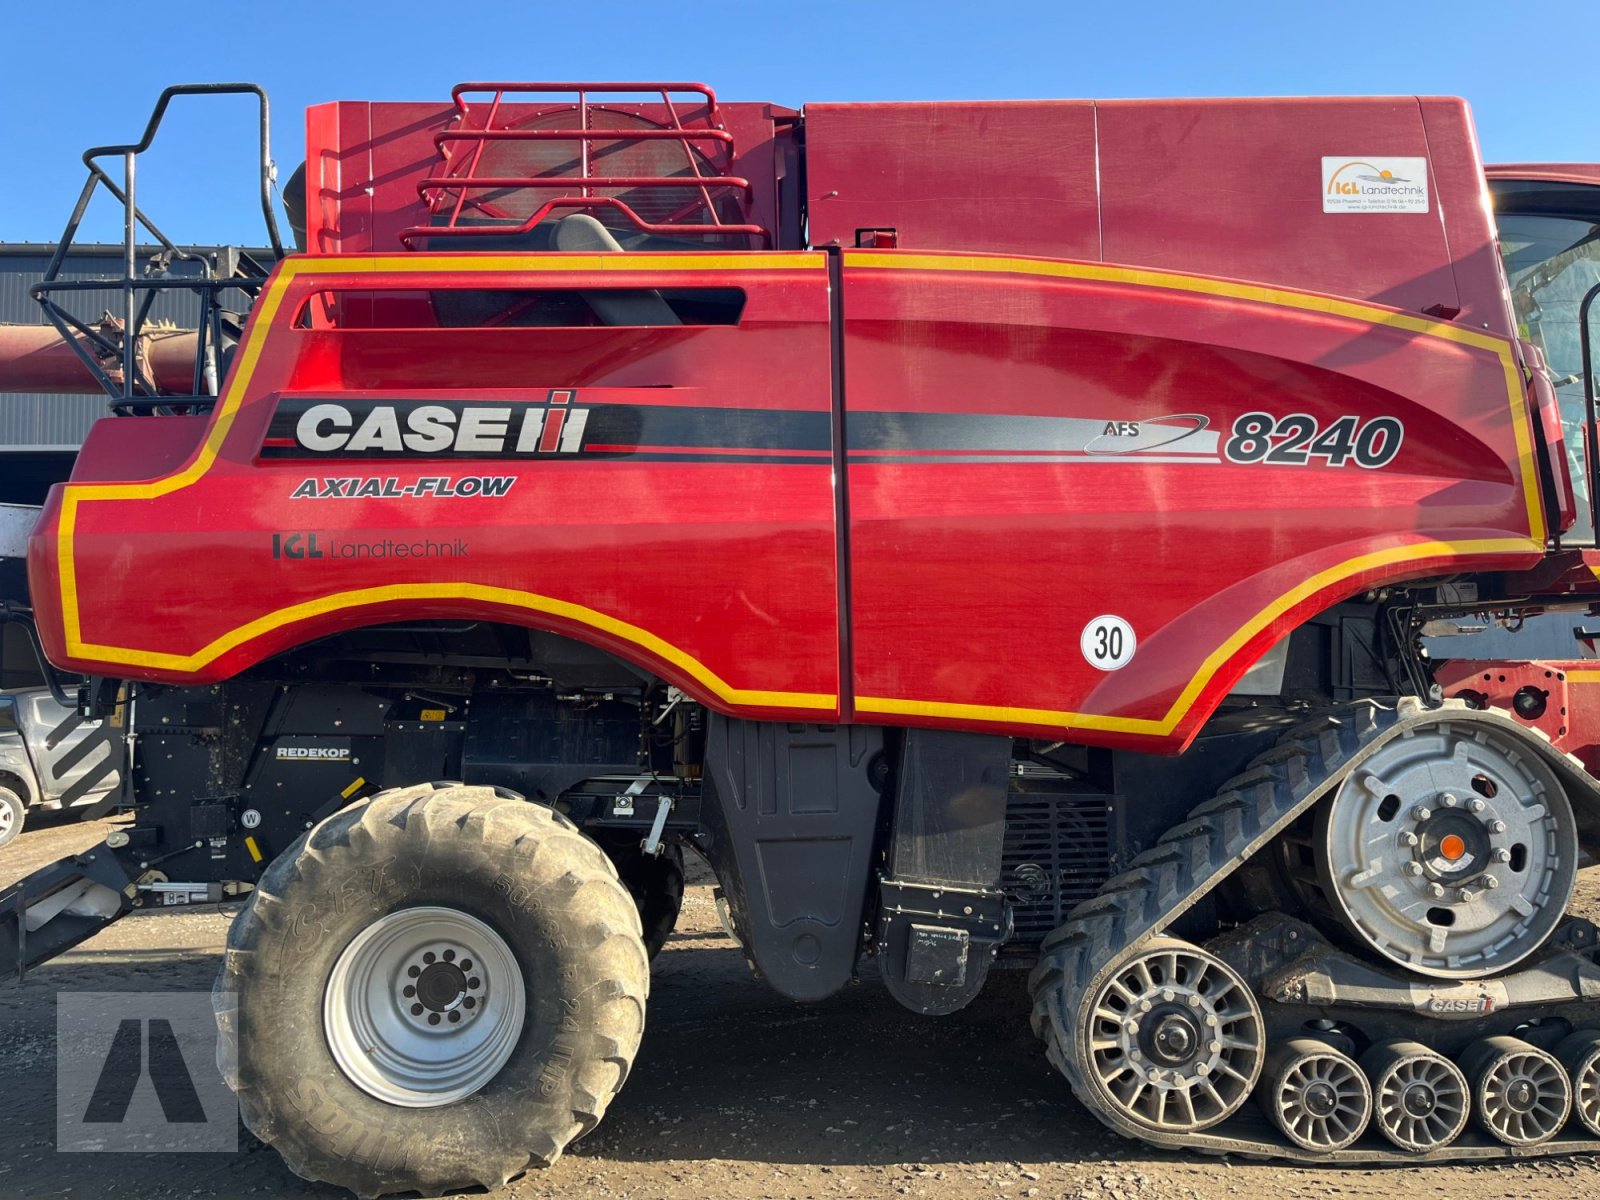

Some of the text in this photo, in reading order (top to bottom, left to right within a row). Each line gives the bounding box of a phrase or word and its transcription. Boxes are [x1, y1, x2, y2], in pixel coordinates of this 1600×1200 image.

[1335, 182, 1424, 195] IGL Landtechnik
[296, 403, 511, 453] CASE
[1103, 420, 1140, 438] AFS
[1224, 410, 1405, 469] 8240
[290, 476, 518, 499] AXIAL-FLOW
[272, 533, 470, 560] IGL Landtechnik
[1094, 625, 1123, 660] 30
[276, 747, 350, 758] REDEKOP
[1430, 1000, 1478, 1012] CASE
